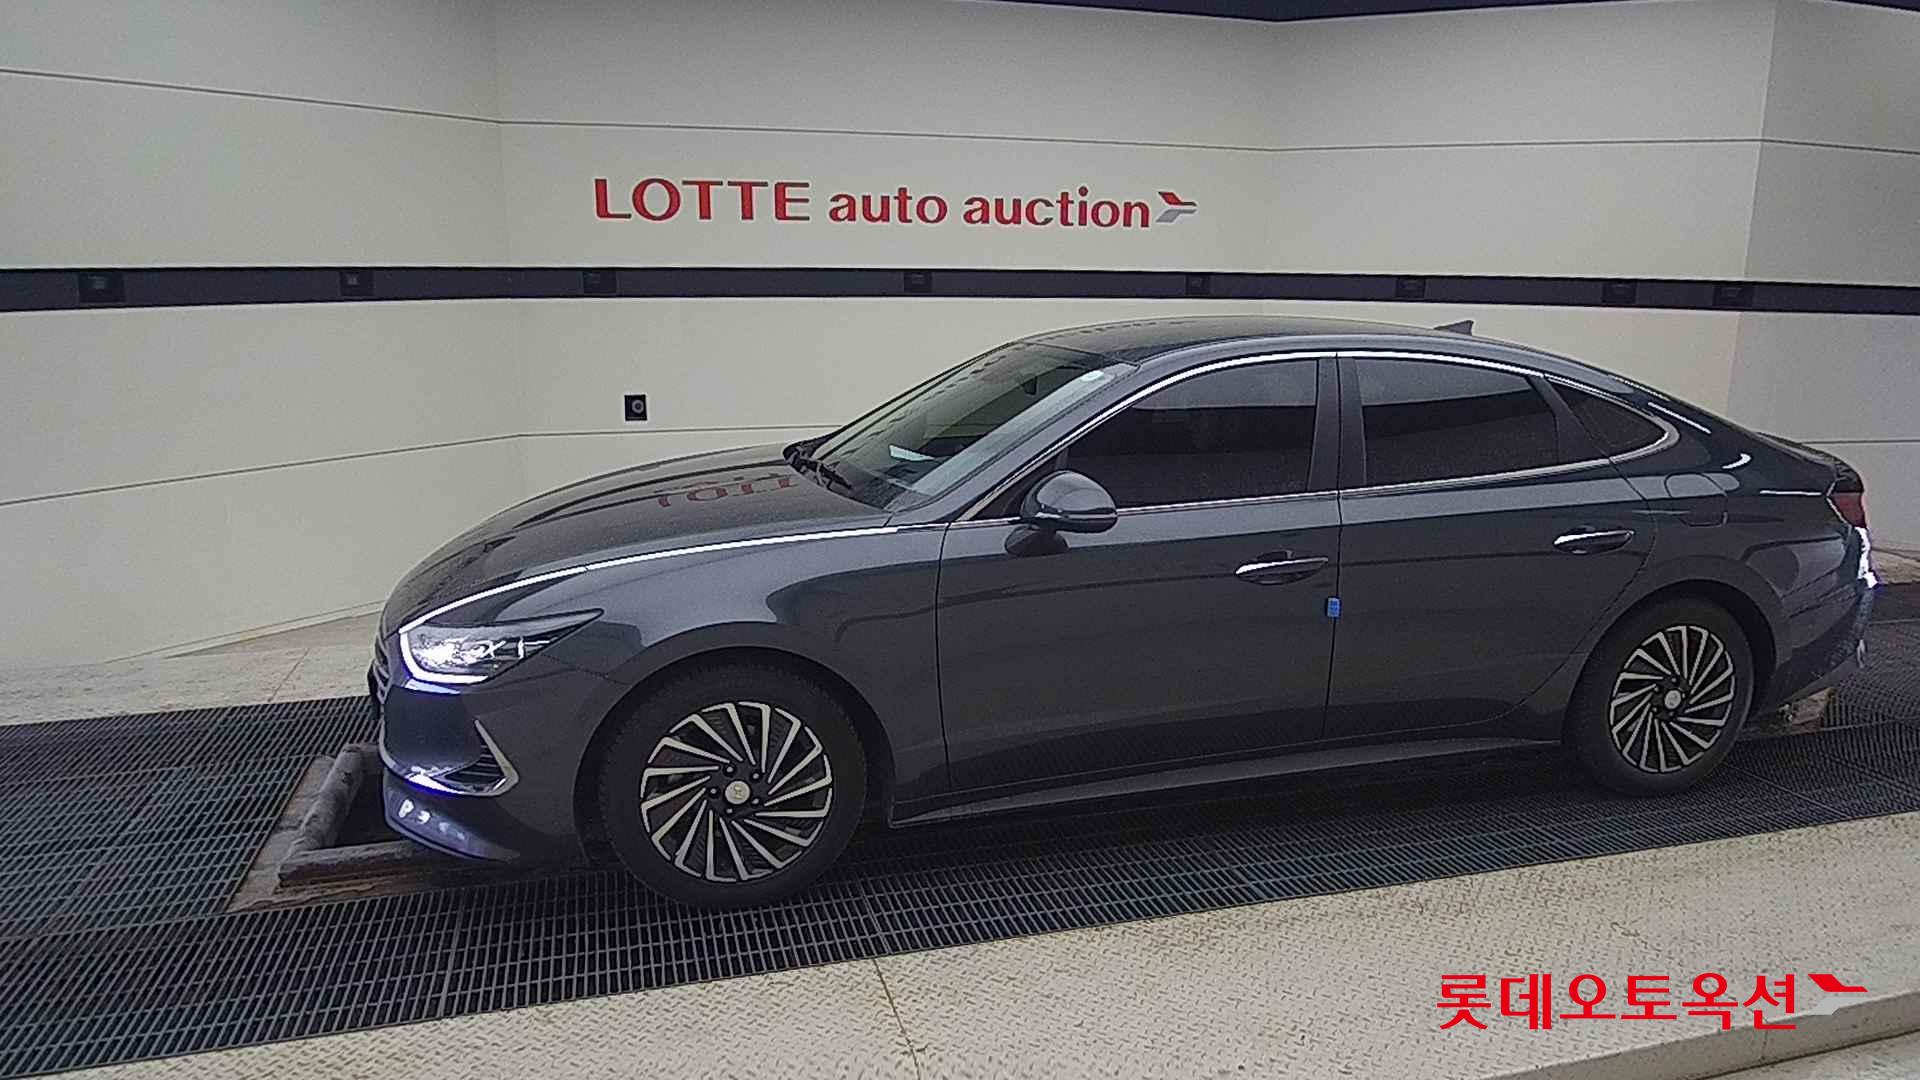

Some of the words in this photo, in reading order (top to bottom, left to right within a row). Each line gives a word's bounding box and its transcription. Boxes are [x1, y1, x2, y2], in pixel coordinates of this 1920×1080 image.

[594, 177, 811, 222] LOTTE
[829, 187, 949, 225] auto
[963, 186, 1151, 228] auction
